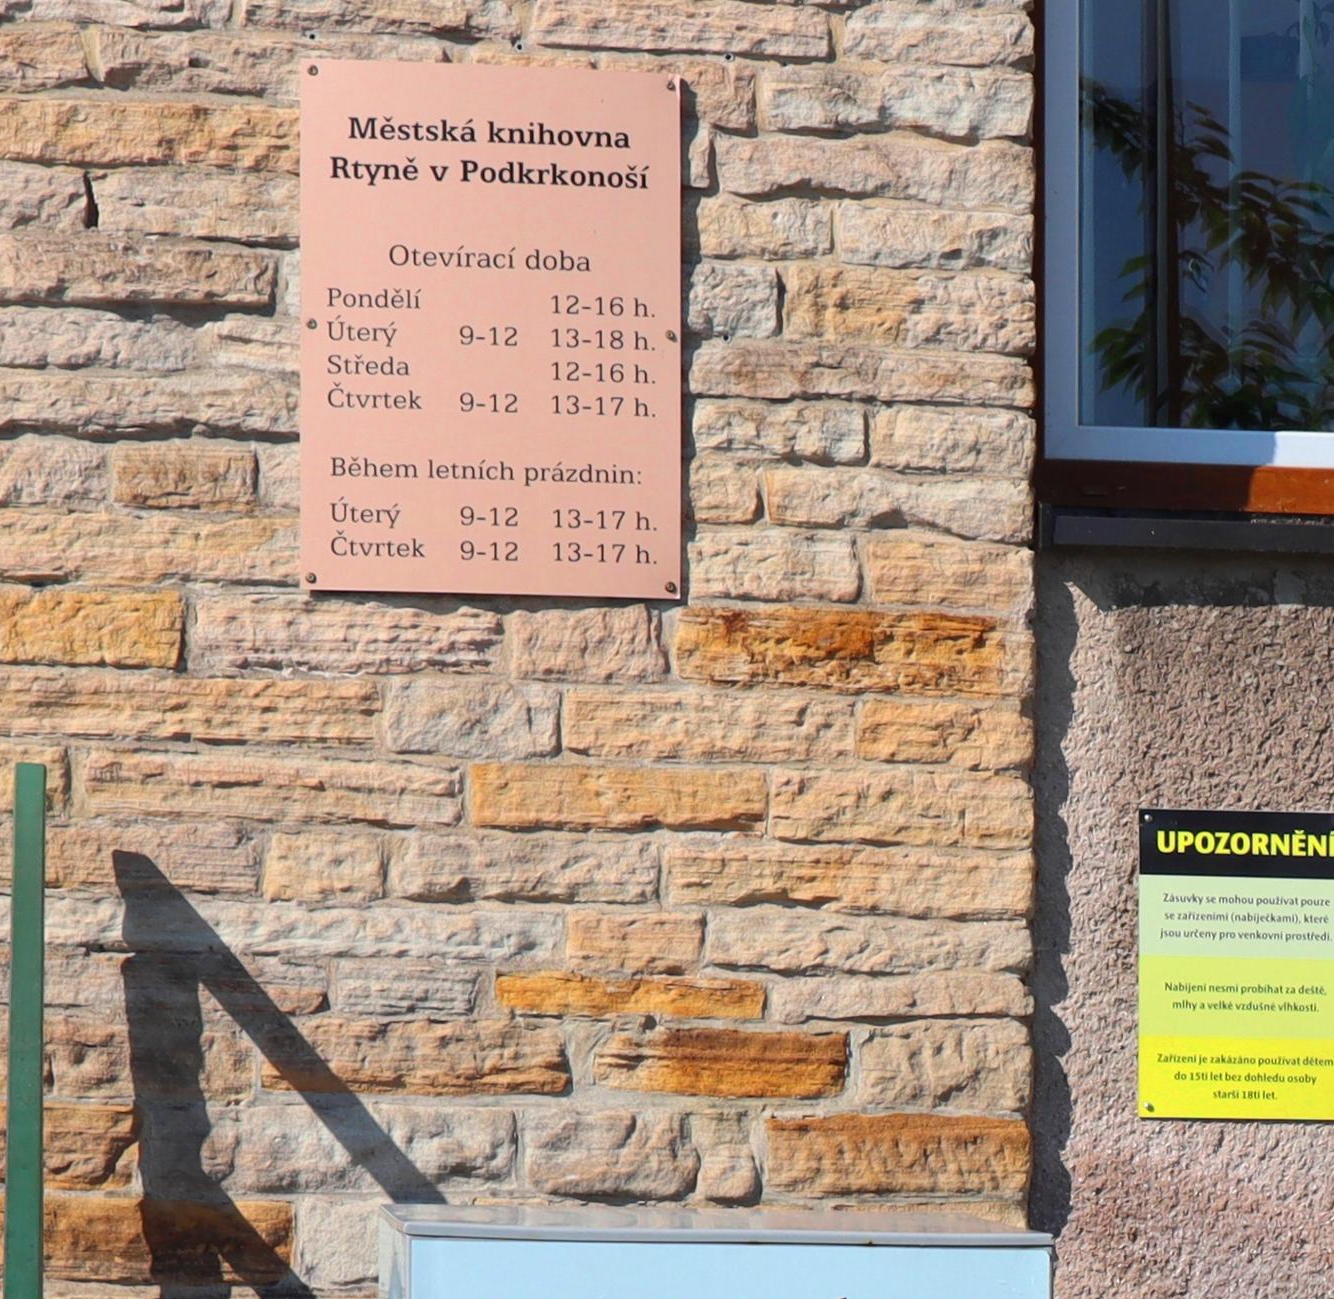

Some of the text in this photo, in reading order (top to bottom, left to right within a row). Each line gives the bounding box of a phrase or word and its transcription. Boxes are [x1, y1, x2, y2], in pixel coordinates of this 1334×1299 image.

[348, 116, 630, 149] Městská knihovna
[330, 156, 649, 189] Rtyně v Podkrkonoší
[389, 244, 591, 272] Otevírací doba
[326, 287, 655, 318] Pondělí 12-16 h.
[327, 315, 655, 351] Úterý 9-12 13-18 h.
[327, 354, 656, 384] Středa 12-16 h.
[327, 382, 656, 418] Čtvrtek 9-12 13-17 h.
[330, 456, 642, 487] Během letních prázdnin:
[330, 496, 657, 531] Úterý 9-12 13-17 h.
[330, 530, 657, 565] Čtvrtek 9-12 13-17 h.
[1163, 893, 1331, 908] Zásuvky se mohou používat pouze
[1164, 911, 1329, 924] se zařízeními (nabíječkami), které
[1160, 929, 1333, 943] jsou určeny pro venkovní prostředí.
[1165, 982, 1206, 994] Nabíjení
[1209, 984, 1239, 994] nesmí
[1241, 984, 1283, 995] probíhat
[1286, 986, 1296, 994] za
[1173, 1001, 1197, 1011] mlhy
[1207, 1001, 1233, 1011] velké
[1235, 1001, 1276, 1012] vzdušné
[1278, 1003, 1319, 1013] vlhkosti.
[1157, 1053, 1334, 1067] Zařízení je zakázáno používat dětem
[1174, 1071, 1317, 1085] do 15ti let bez dohledu osoby
[1213, 1089, 1278, 1100] starší 18ti let.
